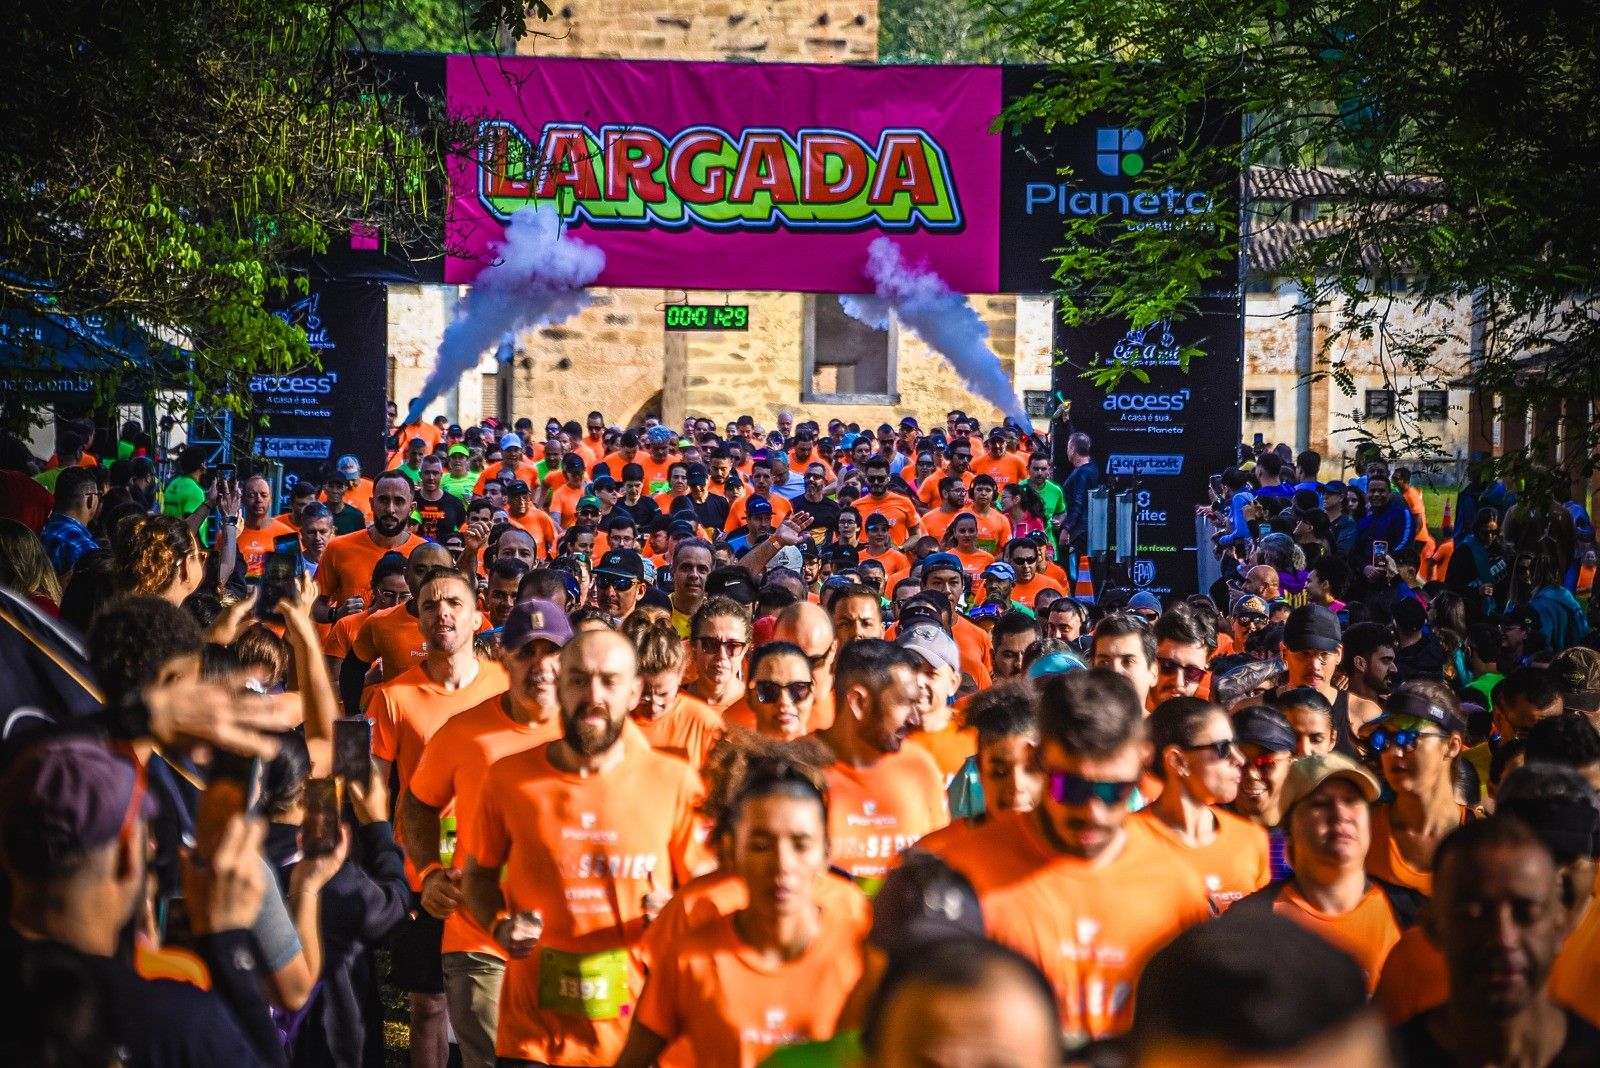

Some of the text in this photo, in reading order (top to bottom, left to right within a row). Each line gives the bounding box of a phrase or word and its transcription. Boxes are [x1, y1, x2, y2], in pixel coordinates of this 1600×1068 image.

[480, 122, 956, 226] LARGADA
[1026, 184, 1215, 215] Planeta
[250, 377, 332, 393] access
[1103, 395, 1185, 411] access
[269, 440, 327, 453] quartzolit
[1121, 458, 1180, 469] quartzolit
